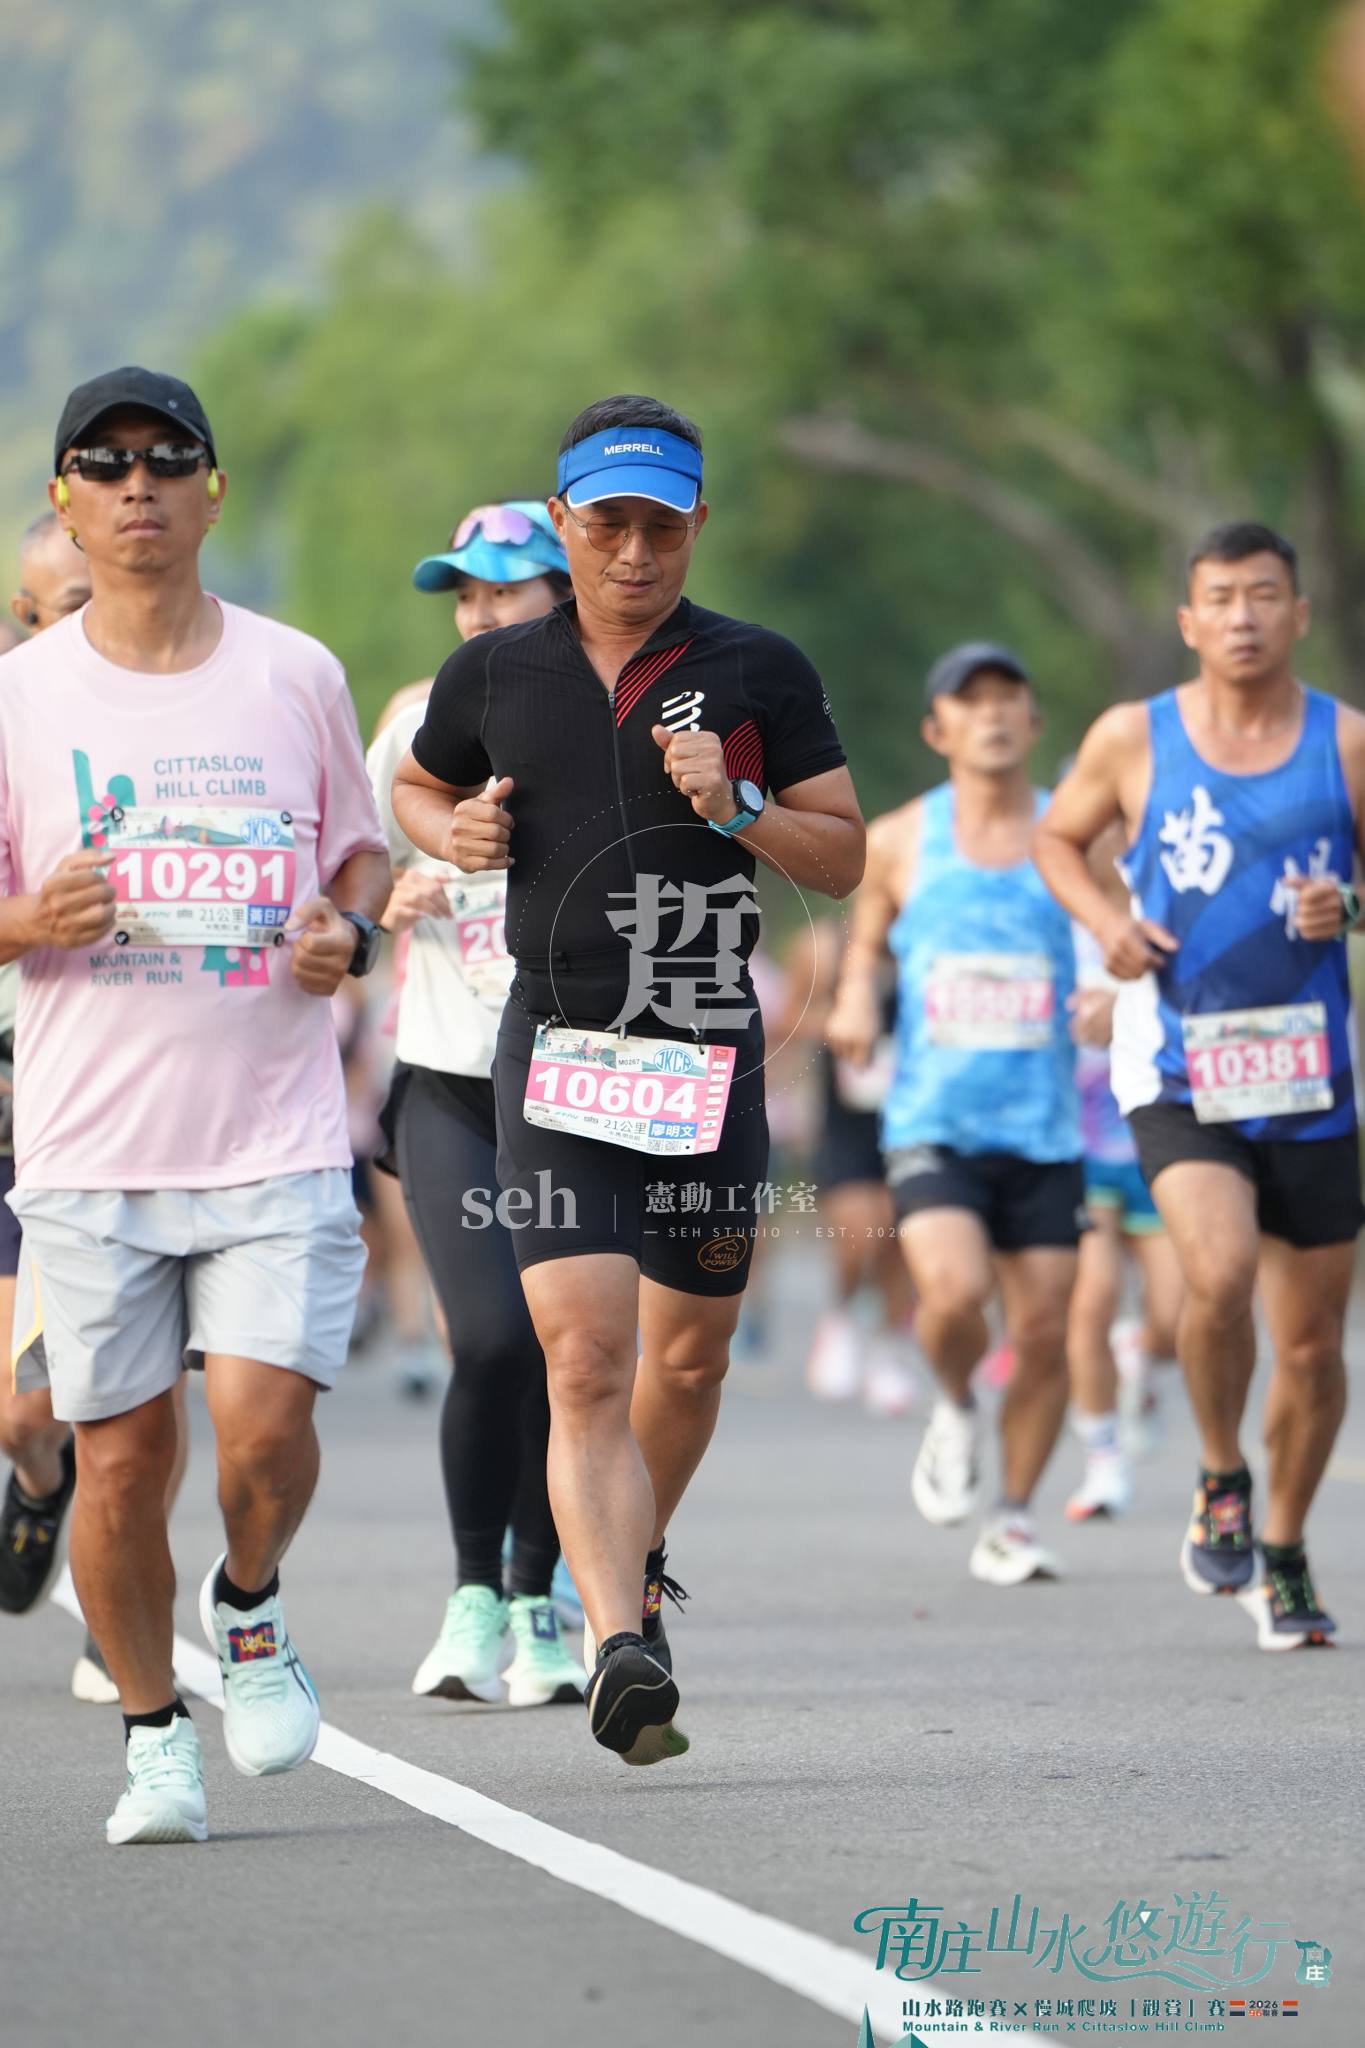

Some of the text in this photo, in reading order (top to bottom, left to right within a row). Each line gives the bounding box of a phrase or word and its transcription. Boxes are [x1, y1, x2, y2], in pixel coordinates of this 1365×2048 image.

[604, 443, 664, 456] MERRELL
[154, 755, 264, 775] CITTASLOW
[155, 778, 266, 799] HILL CLIMB
[116, 851, 286, 903] 10291
[90, 951, 182, 968] MOUNTAIN &
[146, 970, 183, 985] RUN
[1192, 1039, 1319, 1089] 10381
[535, 1066, 698, 1120] 10604
[604, 1119, 647, 1135] 21公里
[650, 1123, 696, 1138] 廖明文
